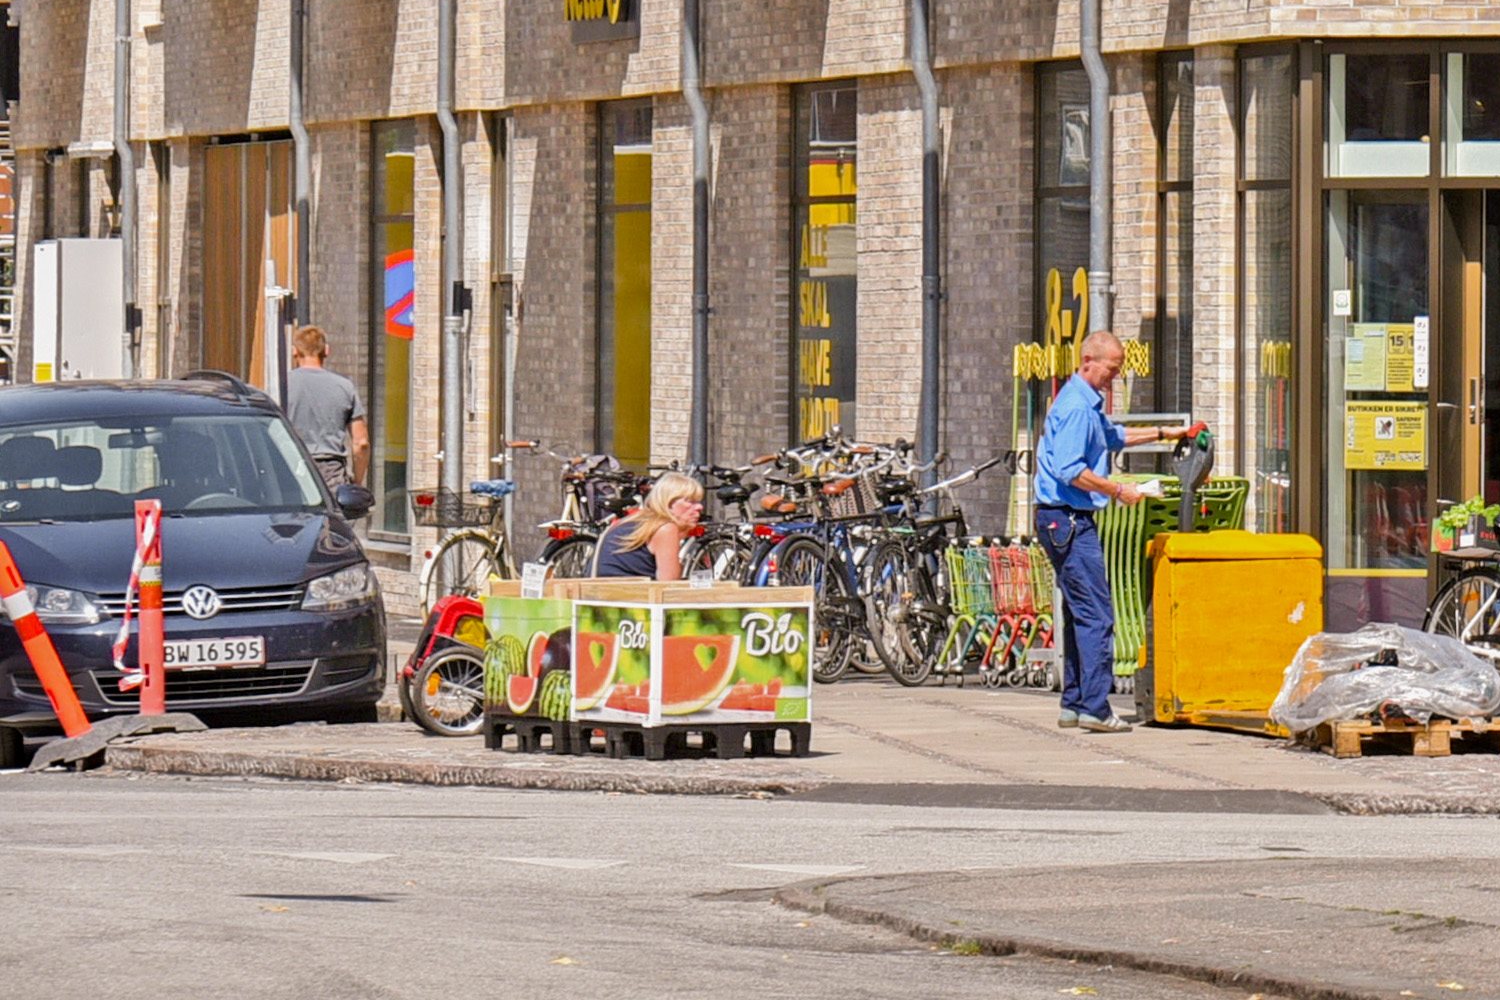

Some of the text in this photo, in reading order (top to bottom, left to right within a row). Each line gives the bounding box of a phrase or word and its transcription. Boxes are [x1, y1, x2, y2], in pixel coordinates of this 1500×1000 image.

[800, 281, 831, 328] SKAL
[799, 339, 831, 386] HAVE
[197, 643, 219, 662] 16
[224, 641, 260, 660] 595
[618, 619, 649, 649] Bio
[741, 611, 804, 656] Bio
